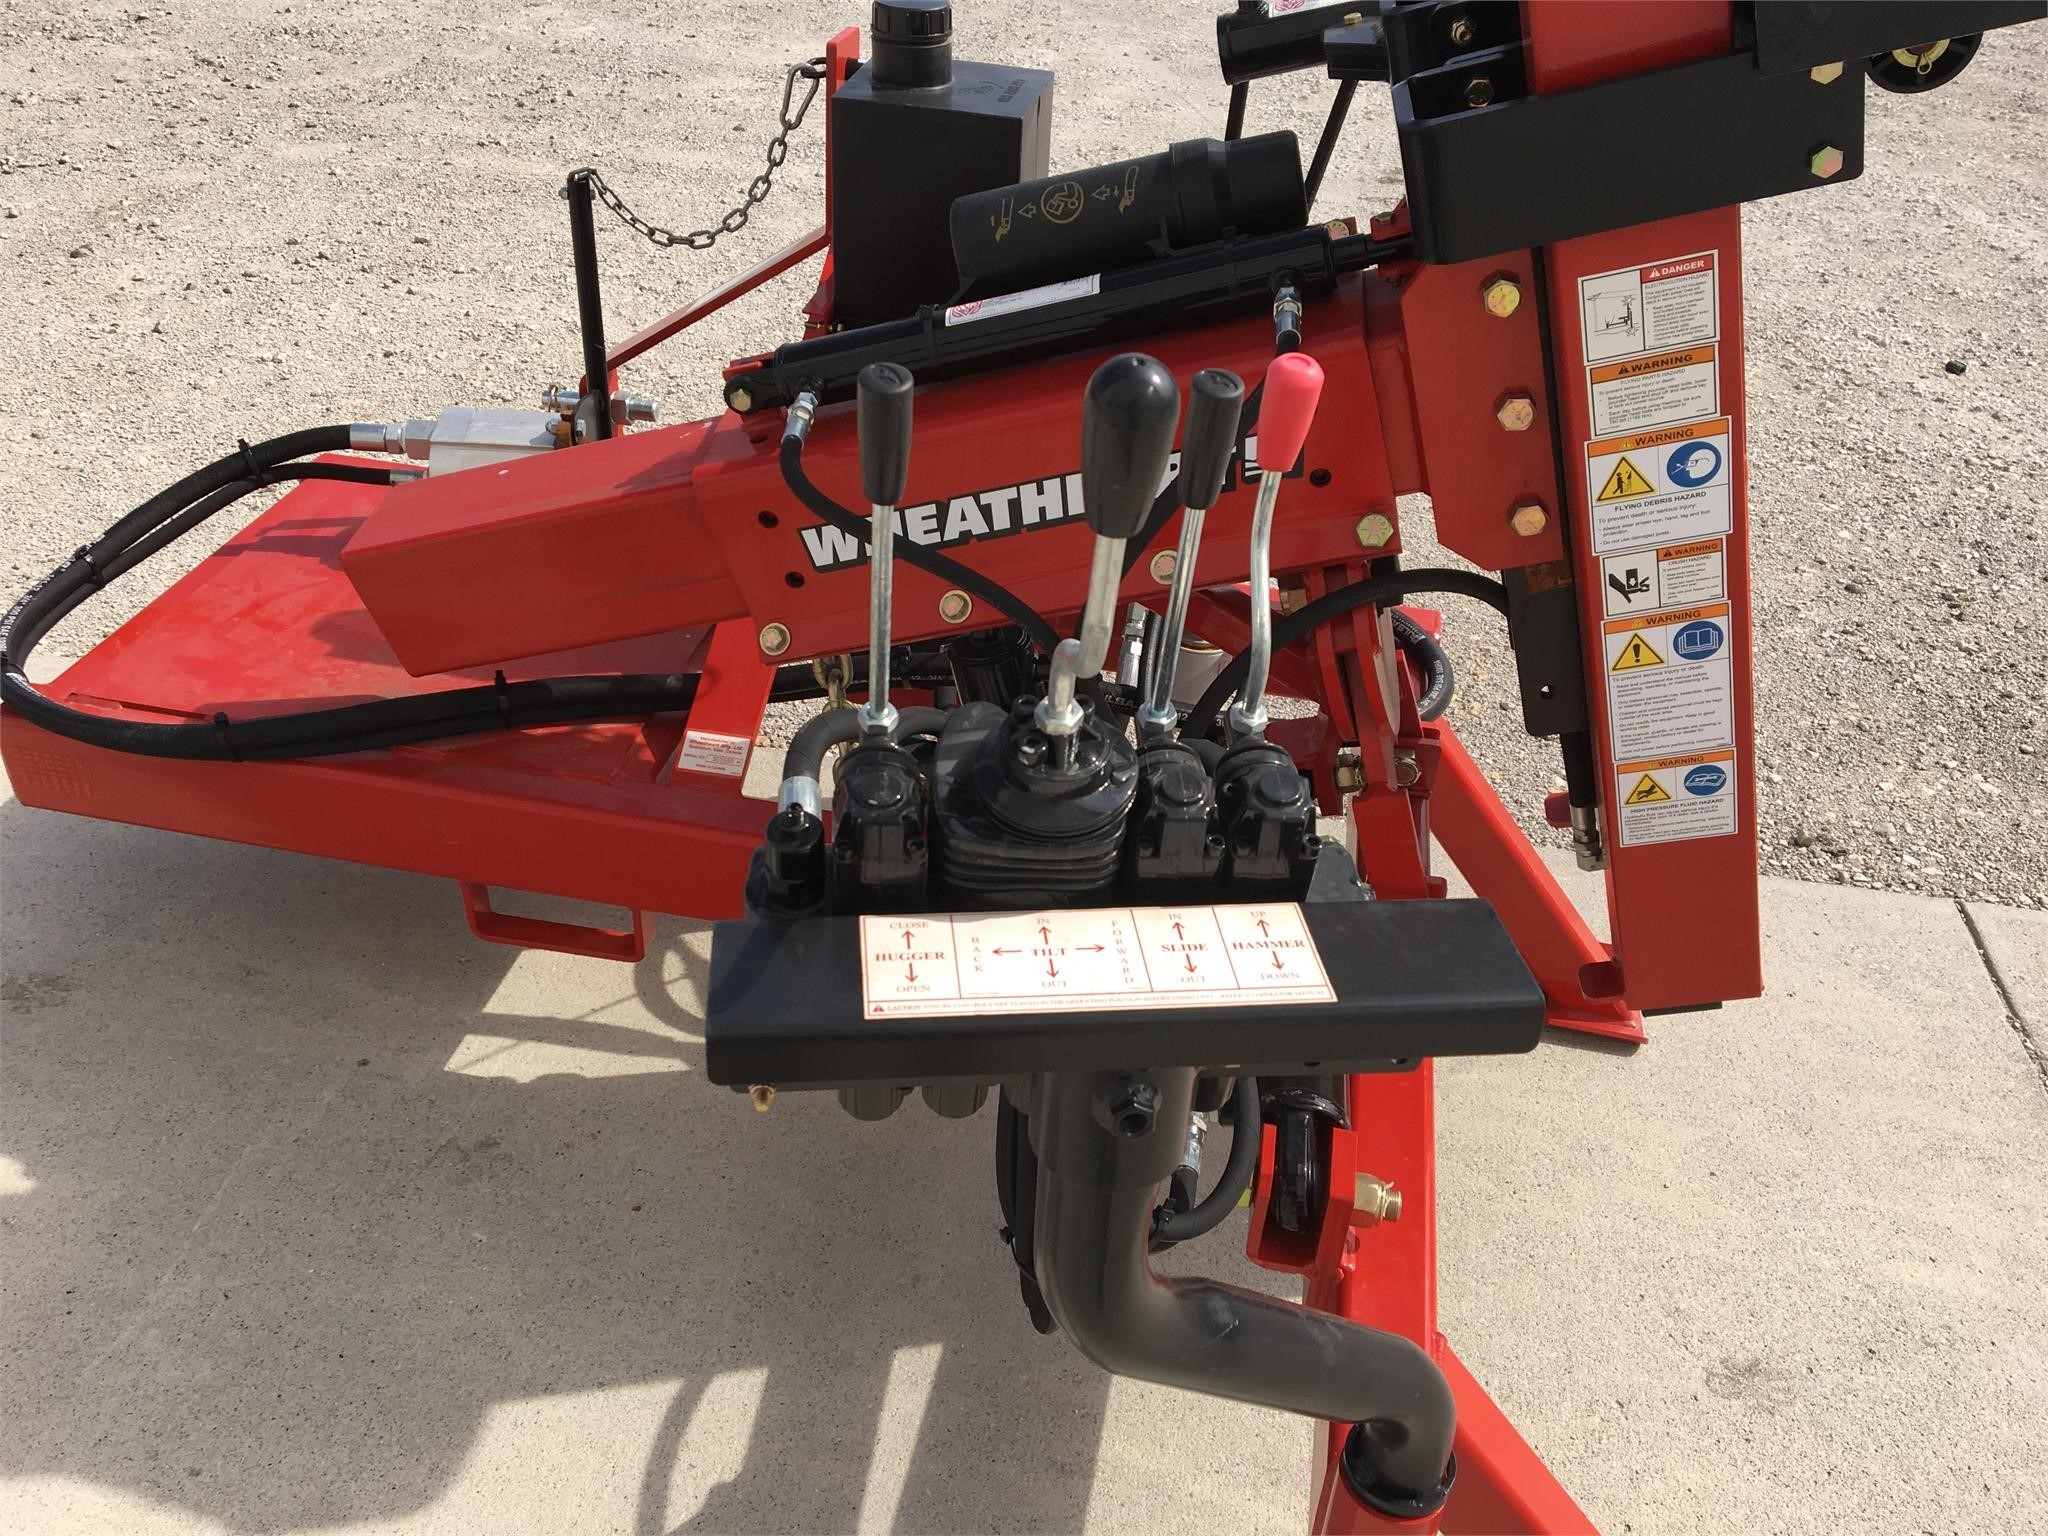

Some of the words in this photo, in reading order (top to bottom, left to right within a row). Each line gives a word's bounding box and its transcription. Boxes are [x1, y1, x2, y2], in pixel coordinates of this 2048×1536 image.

[1661, 259, 1704, 275] DANGER
[1630, 353, 1692, 372] WARNING
[1620, 376, 1640, 385] FLYING
[1641, 373, 1660, 381] PARTS
[1661, 368, 1685, 377] HAZARD
[1635, 428, 1693, 445] WARNING
[1614, 501, 1642, 512] FLYING
[1643, 496, 1672, 507] DEBRIS
[1674, 491, 1706, 502] HAZARD
[1607, 513, 1629, 523] prevent
[1630, 510, 1647, 518] death
[1656, 505, 1677, 514] serious
[1674, 542, 1718, 555] WARNING
[1646, 609, 1700, 625] WARNING
[1659, 755, 1704, 767] WARNING
[1646, 803, 1678, 811] PRESSURE
[1698, 797, 1724, 805] HAZARD
[1168, 913, 1183, 921] IN
[1250, 910, 1266, 918] UP
[889, 920, 929, 930] CLOSE
[1036, 917, 1051, 925] IN
[1160, 942, 1209, 954] SLIDE
[1232, 939, 1306, 951] HAMMER
[874, 950, 946, 962] HUGGER
[971, 936, 984, 973] BACK
[1030, 947, 1068, 958] TILT
[1111, 920, 1134, 985] FORWARD
[1180, 975, 1208, 984] OUT
[1260, 971, 1300, 980] DOWN
[896, 984, 930, 993] OPEN
[1042, 979, 1068, 988] OUT
